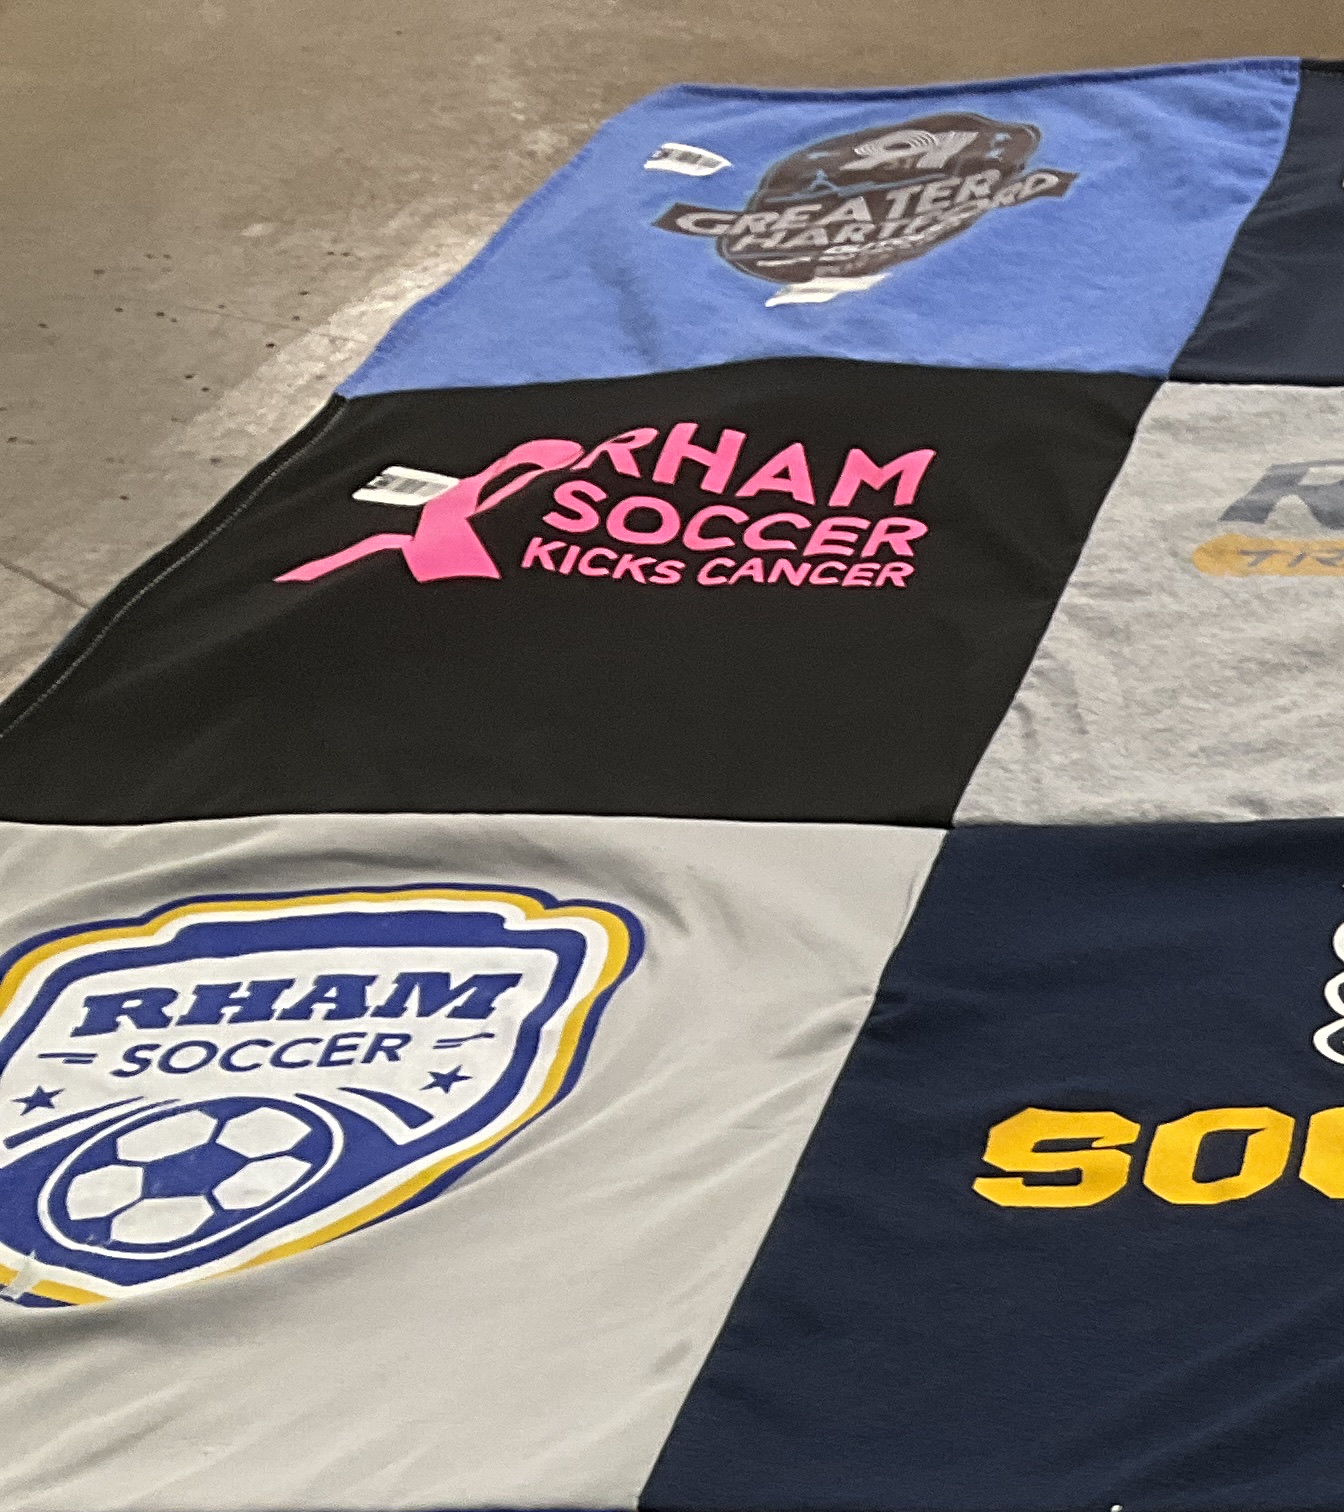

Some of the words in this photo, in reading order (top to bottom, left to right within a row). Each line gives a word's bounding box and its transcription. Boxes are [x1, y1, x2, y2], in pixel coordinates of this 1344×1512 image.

[676, 169, 1002, 236] GREATER
[570, 422, 936, 508] RHAM
[542, 479, 928, 557] SOCCER
[521, 537, 686, 585] KICKS
[697, 556, 915, 588] CANCER
[70, 971, 524, 1037] RHAM
[111, 1031, 412, 1078] SOCCER
